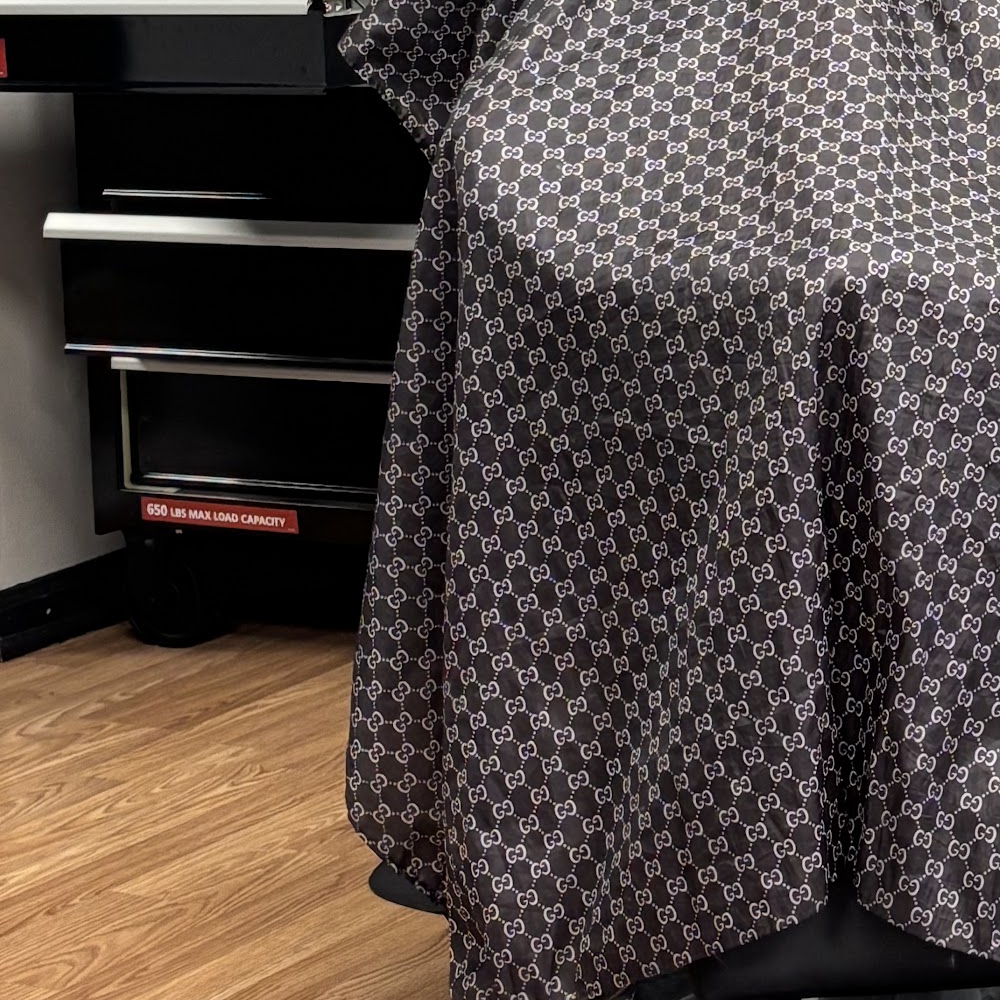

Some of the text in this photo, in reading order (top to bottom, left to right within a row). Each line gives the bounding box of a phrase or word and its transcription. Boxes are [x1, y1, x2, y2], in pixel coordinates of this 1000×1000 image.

[146, 503, 286, 528] 650 LBS MAX LOAD CAPACITY
